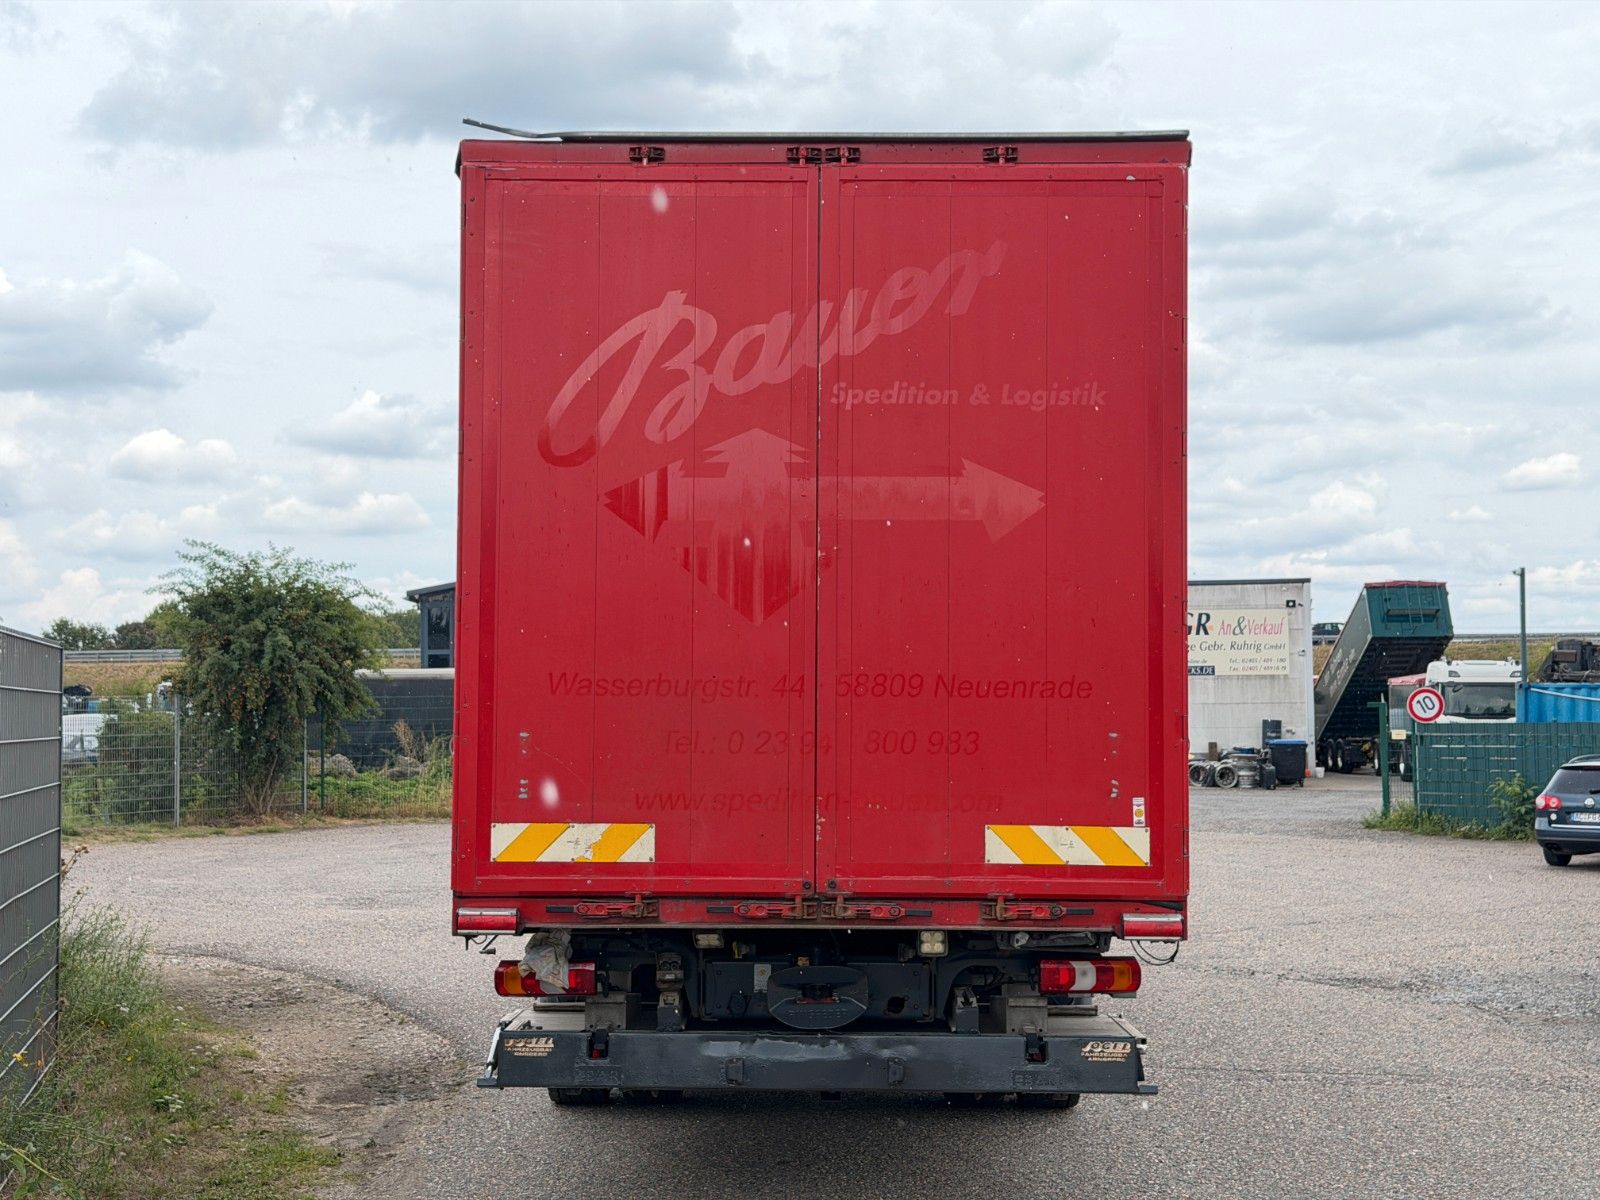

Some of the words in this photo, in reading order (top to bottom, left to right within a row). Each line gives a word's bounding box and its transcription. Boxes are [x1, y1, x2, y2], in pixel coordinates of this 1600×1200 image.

[537, 240, 1008, 468] Bauer
[831, 381, 959, 410] Spedition
[969, 383, 990, 406] &
[1000, 381, 1106, 411] Logistik
[1199, 640, 1226, 652] Gebr.
[548, 671, 760, 703] Wasserburgstr.
[771, 674, 805, 698] 44
[835, 672, 924, 698] 58809
[934, 674, 1093, 699] Neuenrade
[1416, 696, 1435, 713] 10
[665, 730, 716, 755] Tel.:
[727, 730, 744, 755] 0
[754, 730, 788, 755] 23
[864, 730, 917, 755] 800
